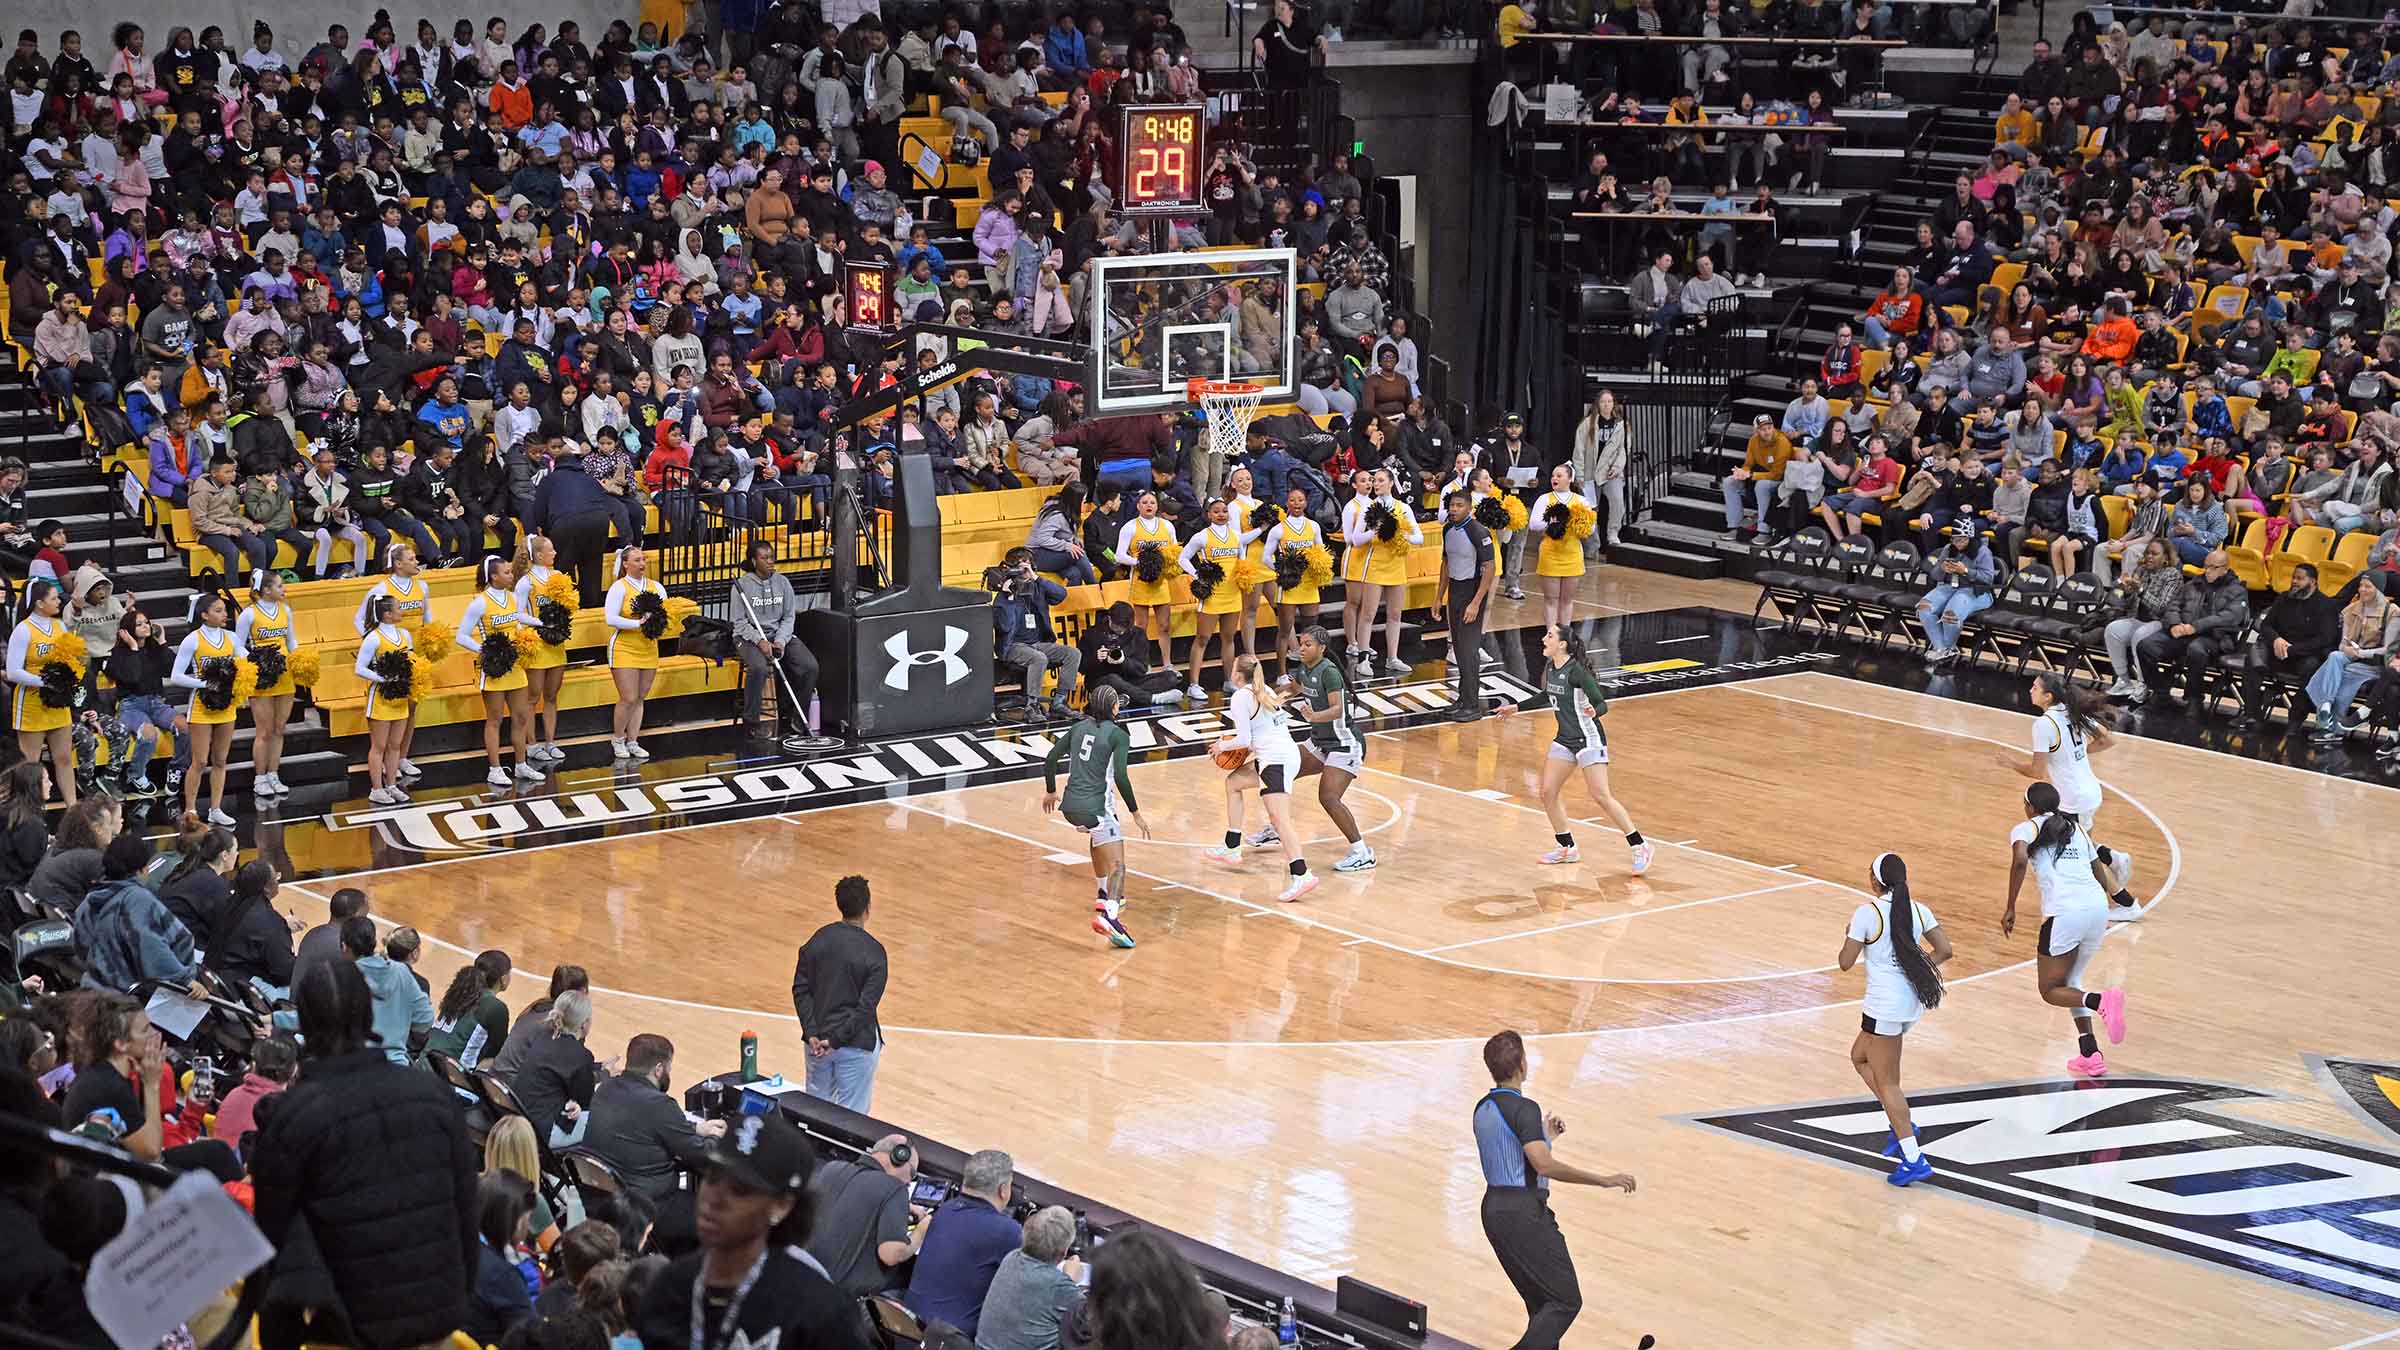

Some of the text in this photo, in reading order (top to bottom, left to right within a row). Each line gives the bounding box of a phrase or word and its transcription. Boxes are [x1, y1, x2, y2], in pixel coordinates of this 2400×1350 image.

[1144, 116, 1193, 144] 9:48
[1136, 147, 1185, 197] 29
[859, 295, 878, 320] 29
[164, 320, 189, 333] GAME
[918, 362, 957, 387] Schelde
[1079, 734, 1096, 761] 5
[744, 1045, 754, 1057] G
